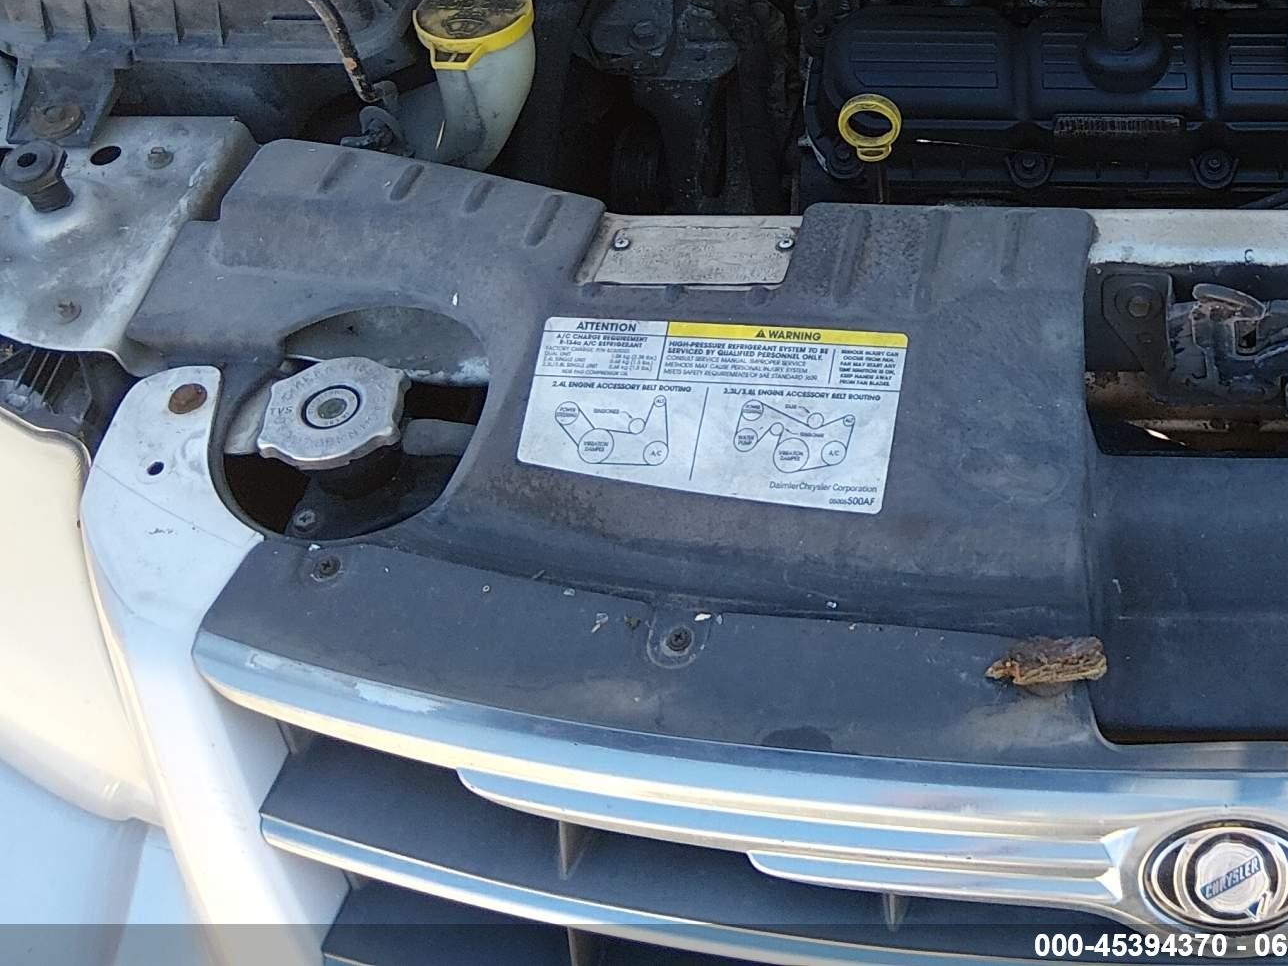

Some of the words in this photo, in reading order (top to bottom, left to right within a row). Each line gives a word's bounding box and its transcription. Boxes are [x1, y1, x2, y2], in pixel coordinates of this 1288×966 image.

[576, 321, 637, 333] ATTENTION
[603, 335, 649, 343] REQUIREMENT
[768, 329, 822, 342] WARNING
[669, 341, 726, 350] HIGH-PRESSURE
[727, 343, 777, 352] REFRIGERANT
[668, 347, 704, 355] SERVICED
[717, 349, 755, 357] QUALIFIED
[757, 352, 800, 360] PERSONNEL
[552, 380, 568, 388] 2.4L
[596, 383, 641, 391] ACCESSORY
[642, 384, 658, 392] BELT
[659, 385, 692, 393] ROUTING
[757, 389, 784, 397] ENGINE
[785, 390, 829, 400] ACCESSORY
[831, 392, 846, 400] BELT
[848, 393, 881, 402] ROUTING
[769, 481, 832, 491] DaimlerChrysler
[833, 481, 878, 493] Corporation
[1204, 856, 1260, 900] CHRYSLER
